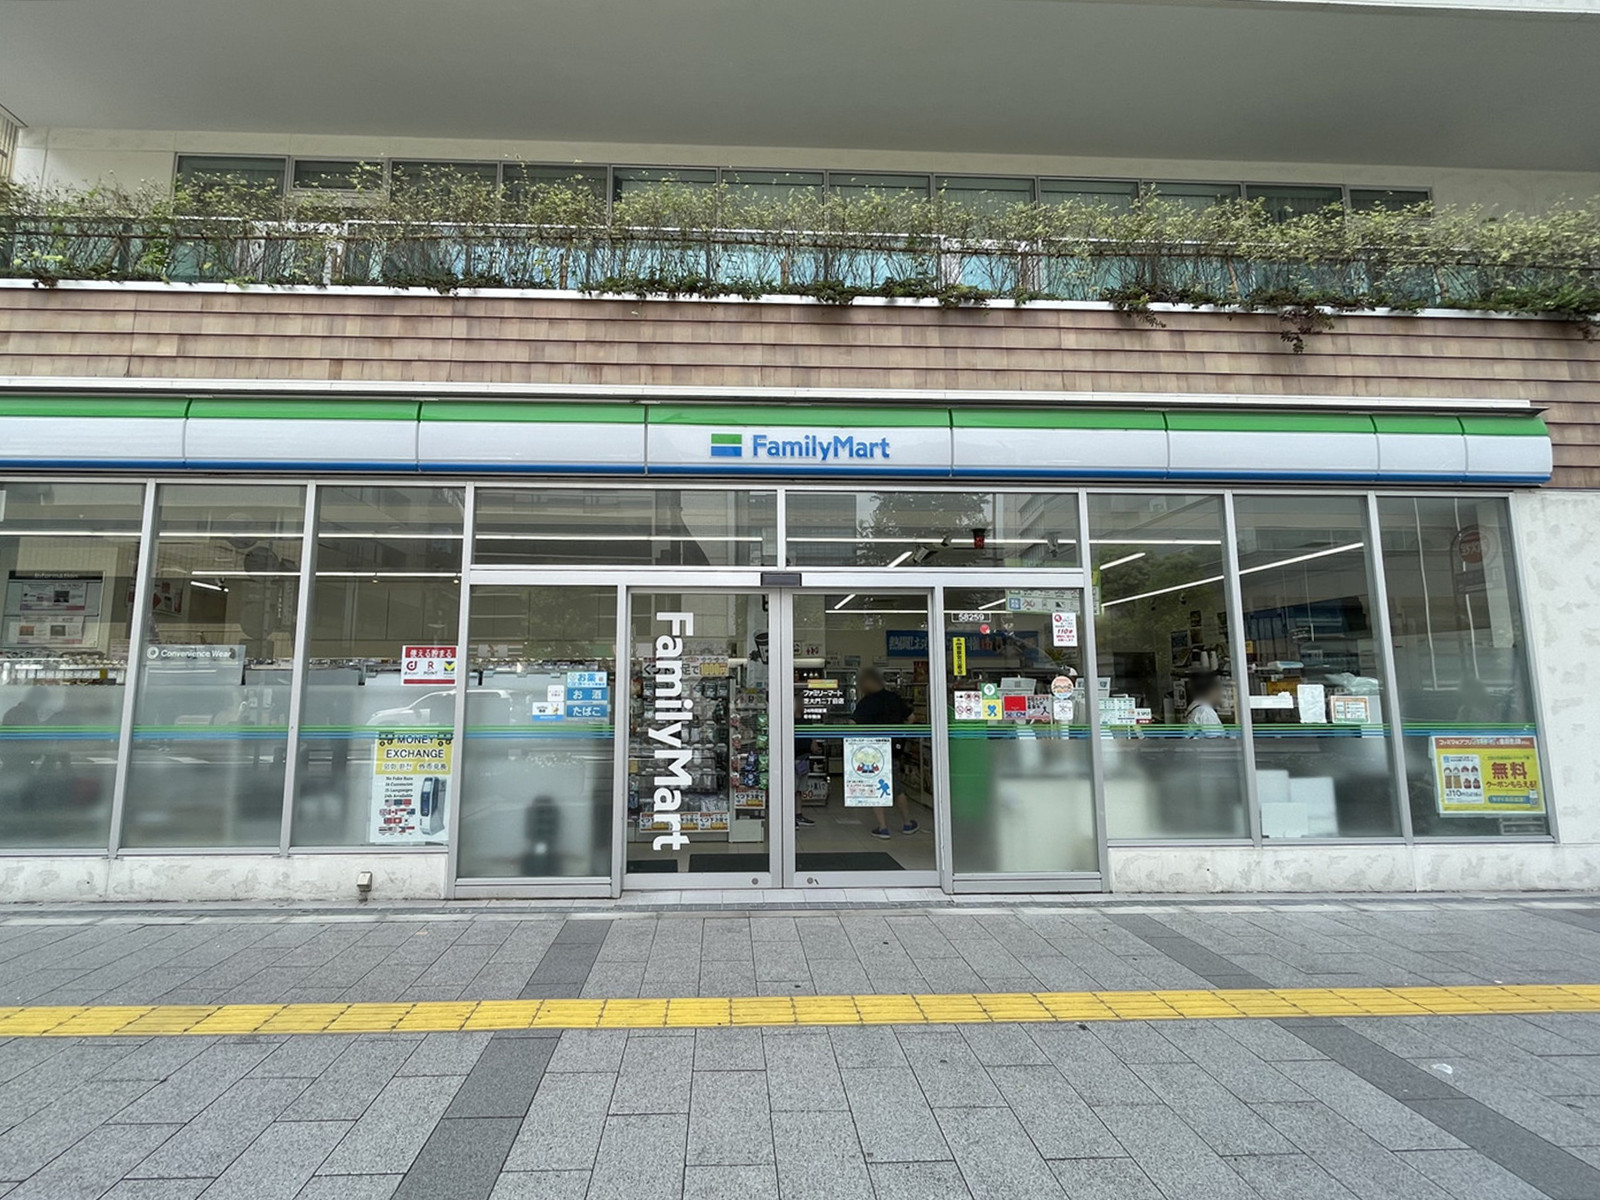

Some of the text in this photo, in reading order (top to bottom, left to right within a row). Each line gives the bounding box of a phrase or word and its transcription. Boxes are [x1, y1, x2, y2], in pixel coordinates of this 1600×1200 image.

[752, 434, 890, 461] FamilyMart
[161, 650, 231, 659] Convenience Wear
[572, 706, 602, 717] たばこ
[648, 612, 694, 851] FamilyMart
[396, 735, 434, 744] MONEY
[386, 749, 444, 758] EXCHANGE
[1492, 762, 1527, 780] 無料
